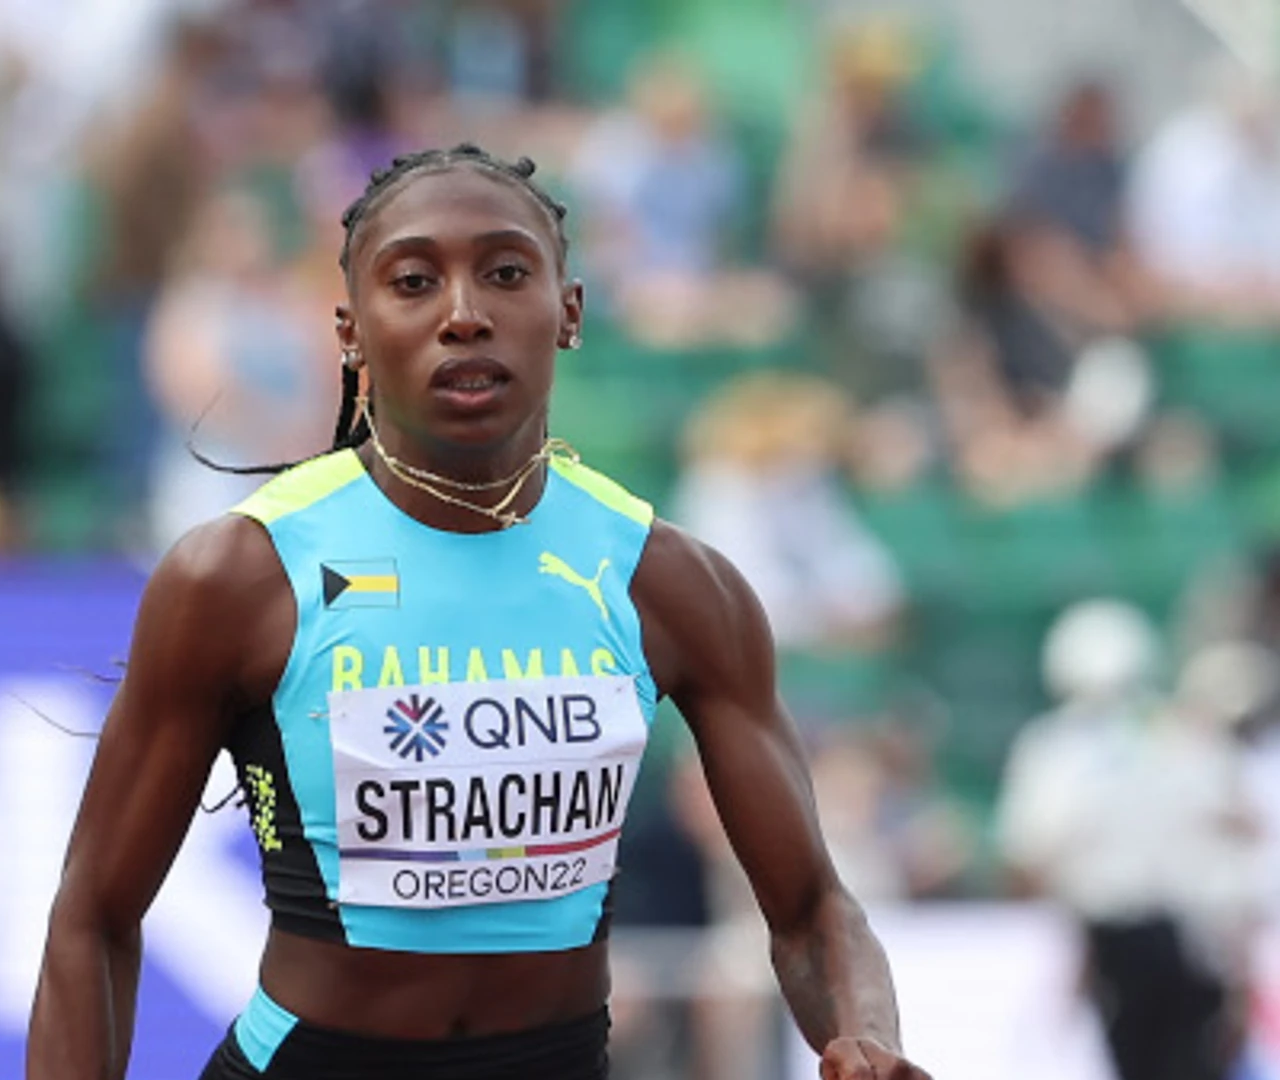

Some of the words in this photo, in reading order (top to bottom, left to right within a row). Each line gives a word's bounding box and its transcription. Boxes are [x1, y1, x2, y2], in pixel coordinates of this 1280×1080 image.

[463, 694, 602, 749] QNB
[355, 764, 623, 842] STRACHAN
[393, 857, 587, 900] OREGON22
